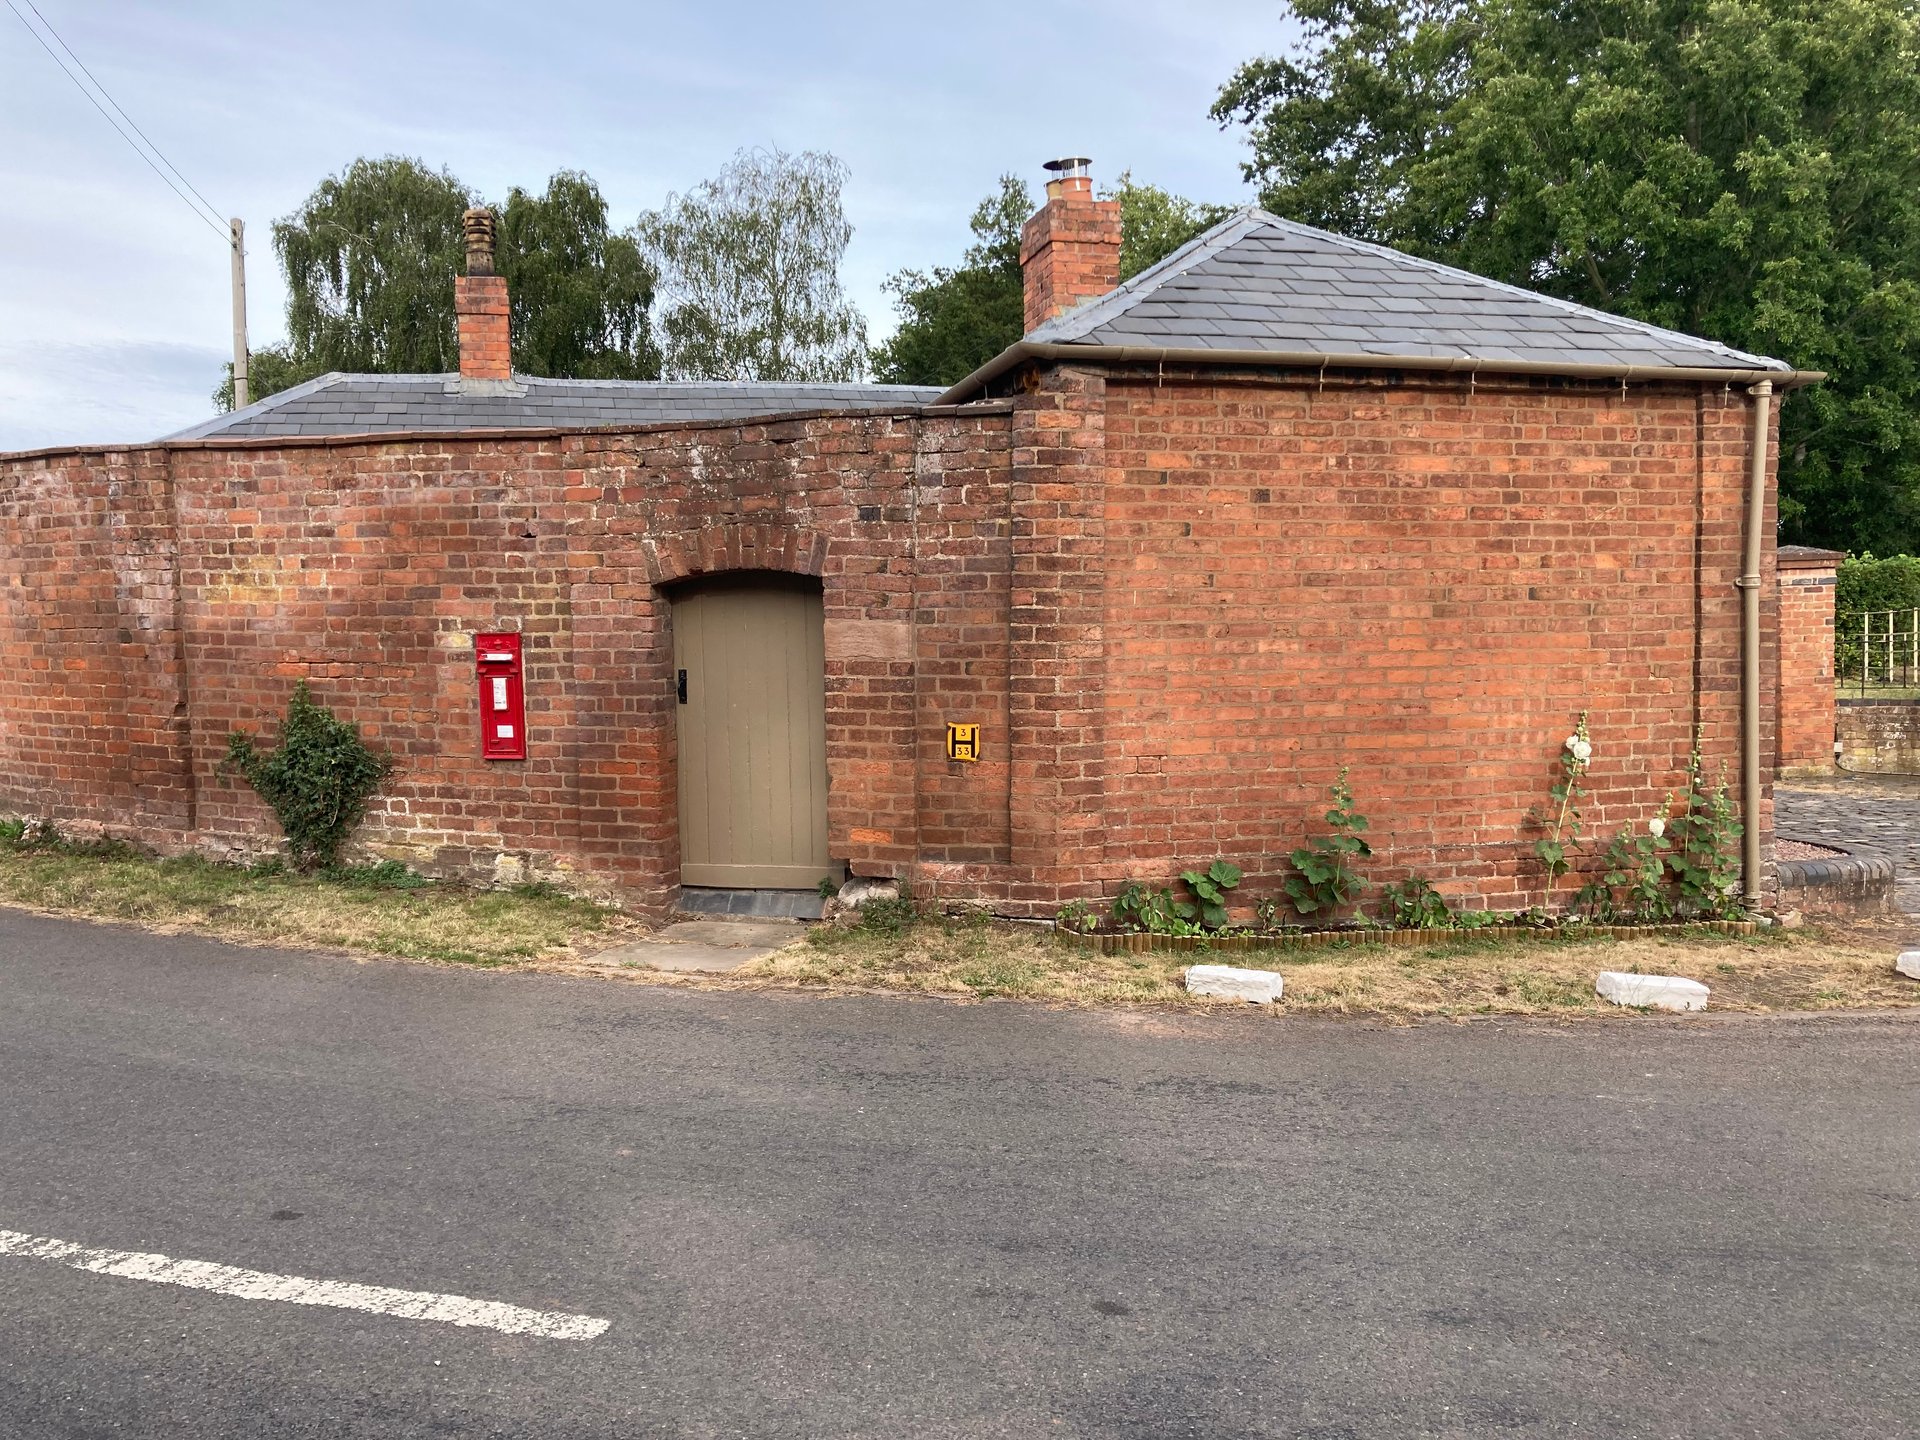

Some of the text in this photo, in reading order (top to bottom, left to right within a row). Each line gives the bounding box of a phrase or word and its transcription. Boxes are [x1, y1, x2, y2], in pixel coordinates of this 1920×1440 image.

[960, 728, 966, 736] 3
[952, 727, 975, 758] H
[957, 747, 969, 755] 33
